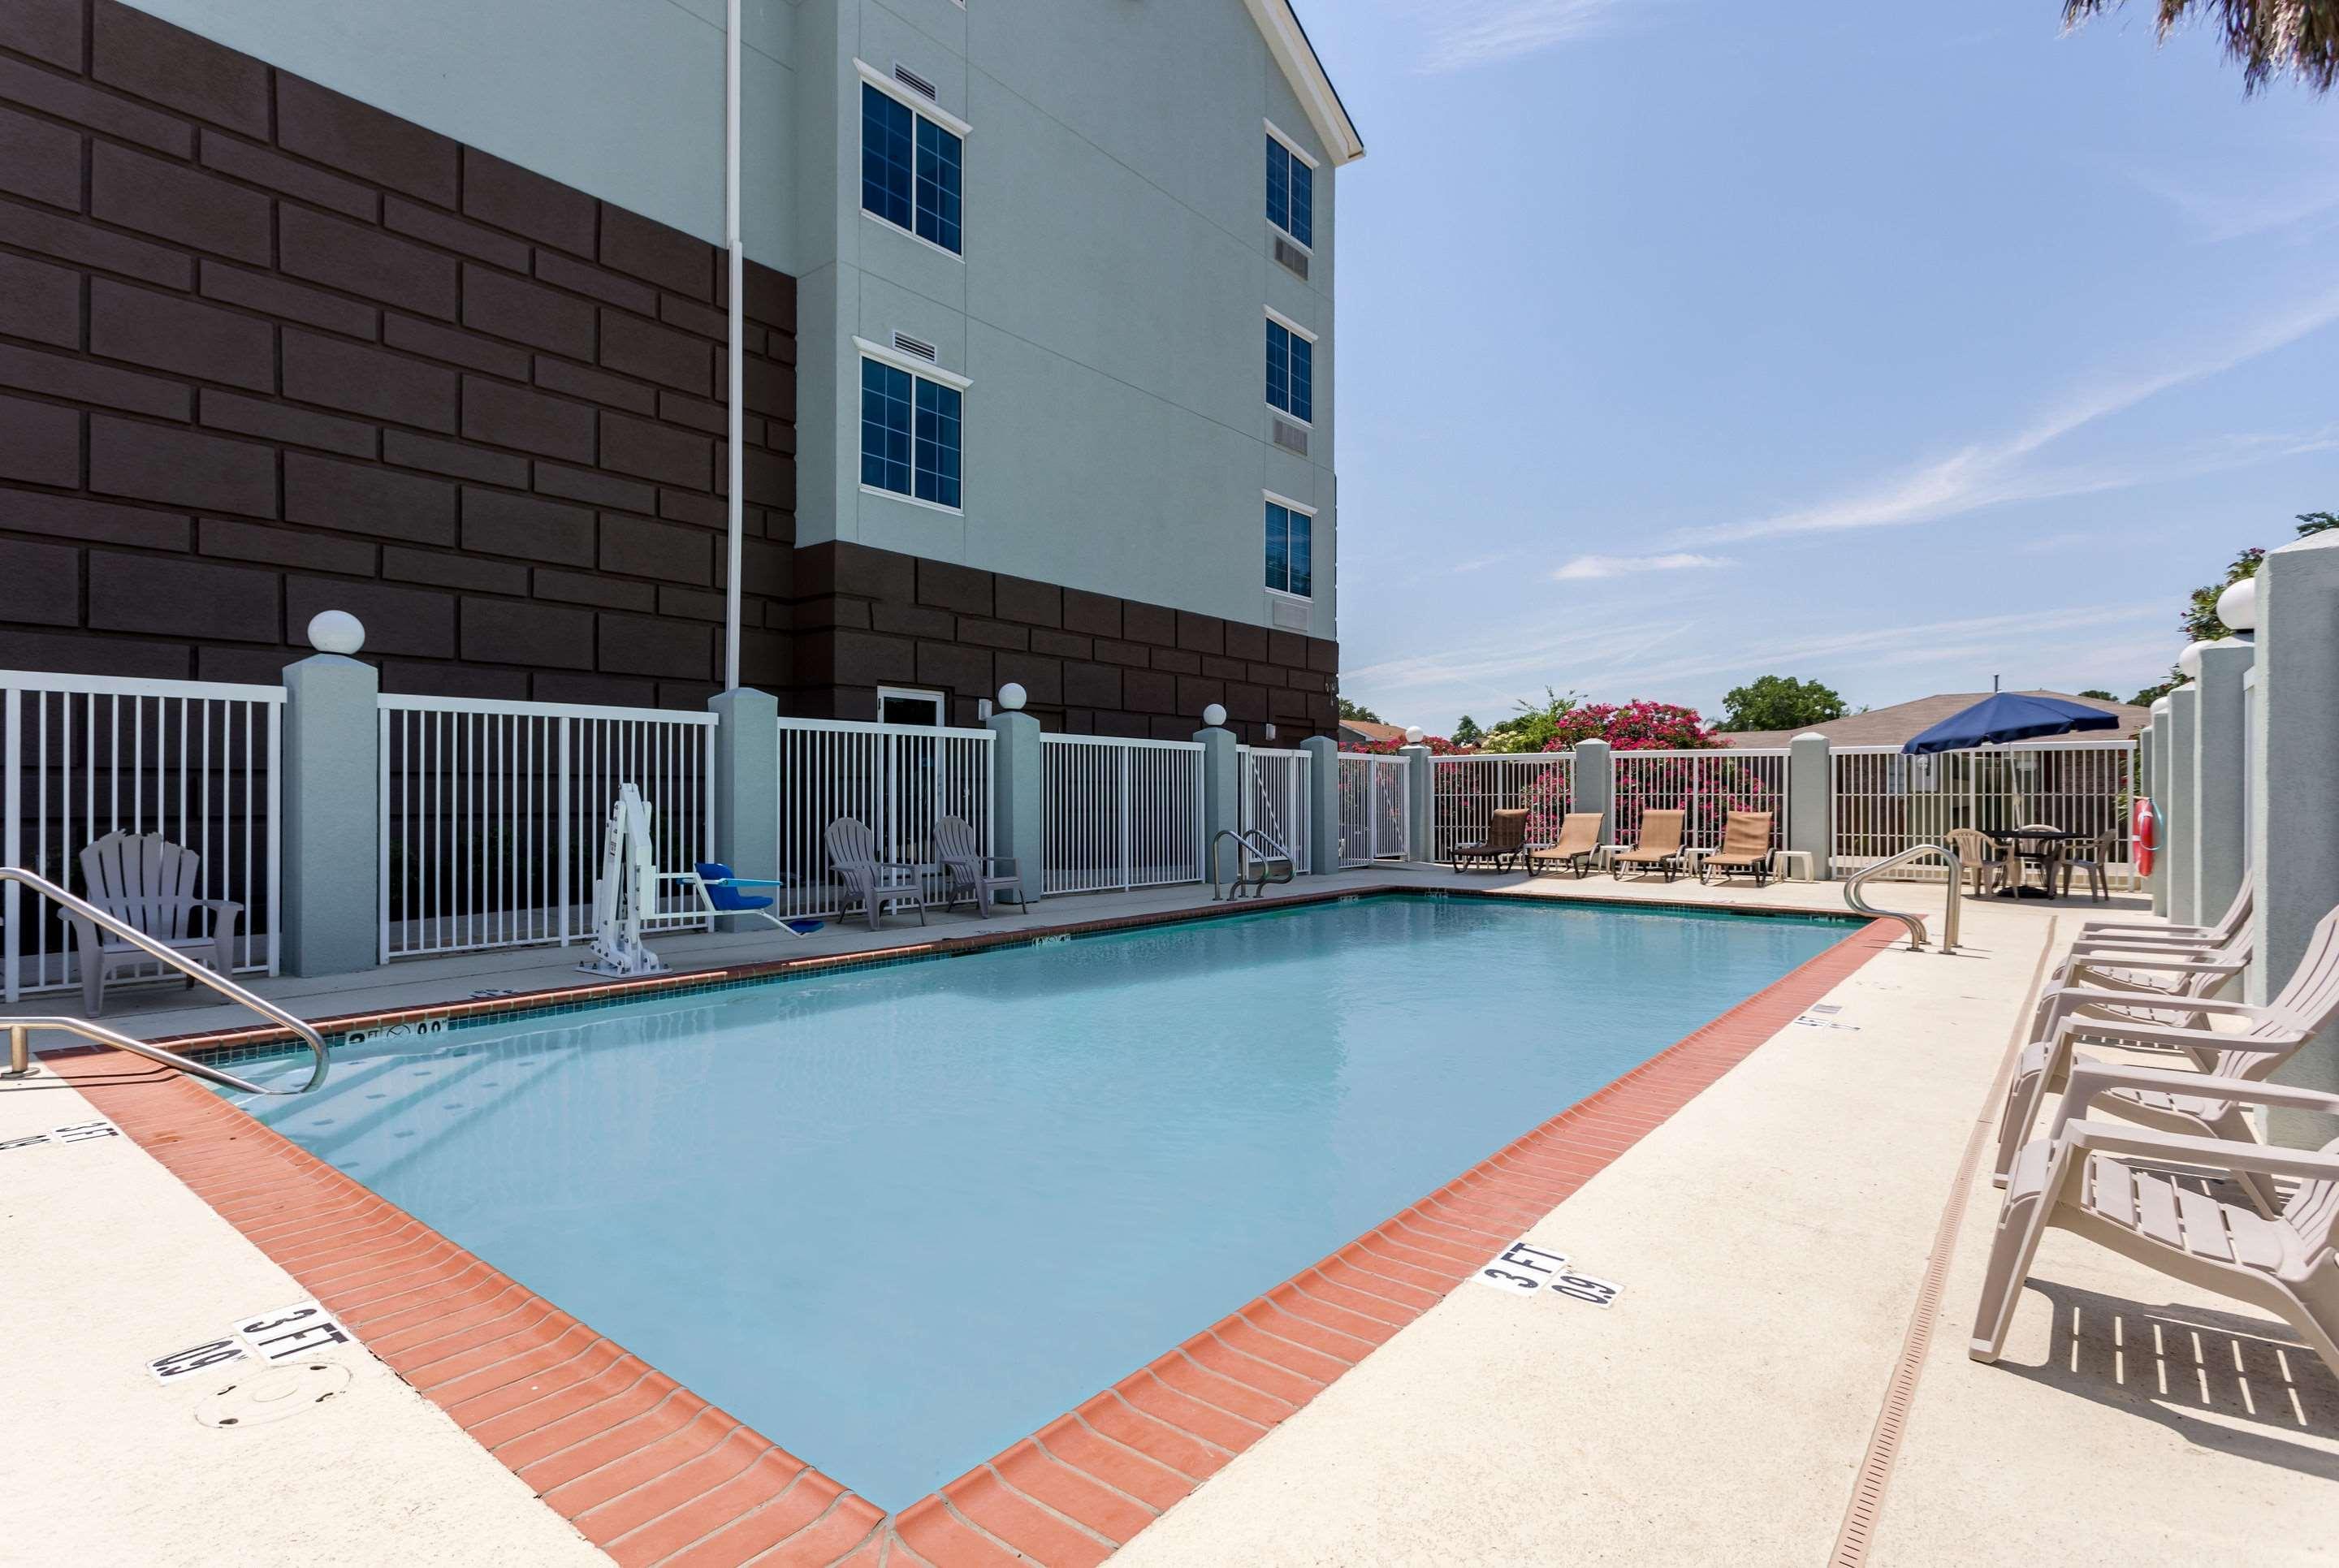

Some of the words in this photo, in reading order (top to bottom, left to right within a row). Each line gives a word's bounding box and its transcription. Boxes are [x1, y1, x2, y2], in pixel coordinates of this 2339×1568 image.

[56, 1122, 109, 1133] 3
[61, 1127, 119, 1143] FT
[1500, 1242, 1565, 1274] FT
[1484, 1268, 1539, 1289] 3
[1551, 1276, 1616, 1304] 0.9
[243, 1308, 318, 1334] 3
[258, 1322, 349, 1359] FT
[153, 1340, 243, 1377] 0.9
